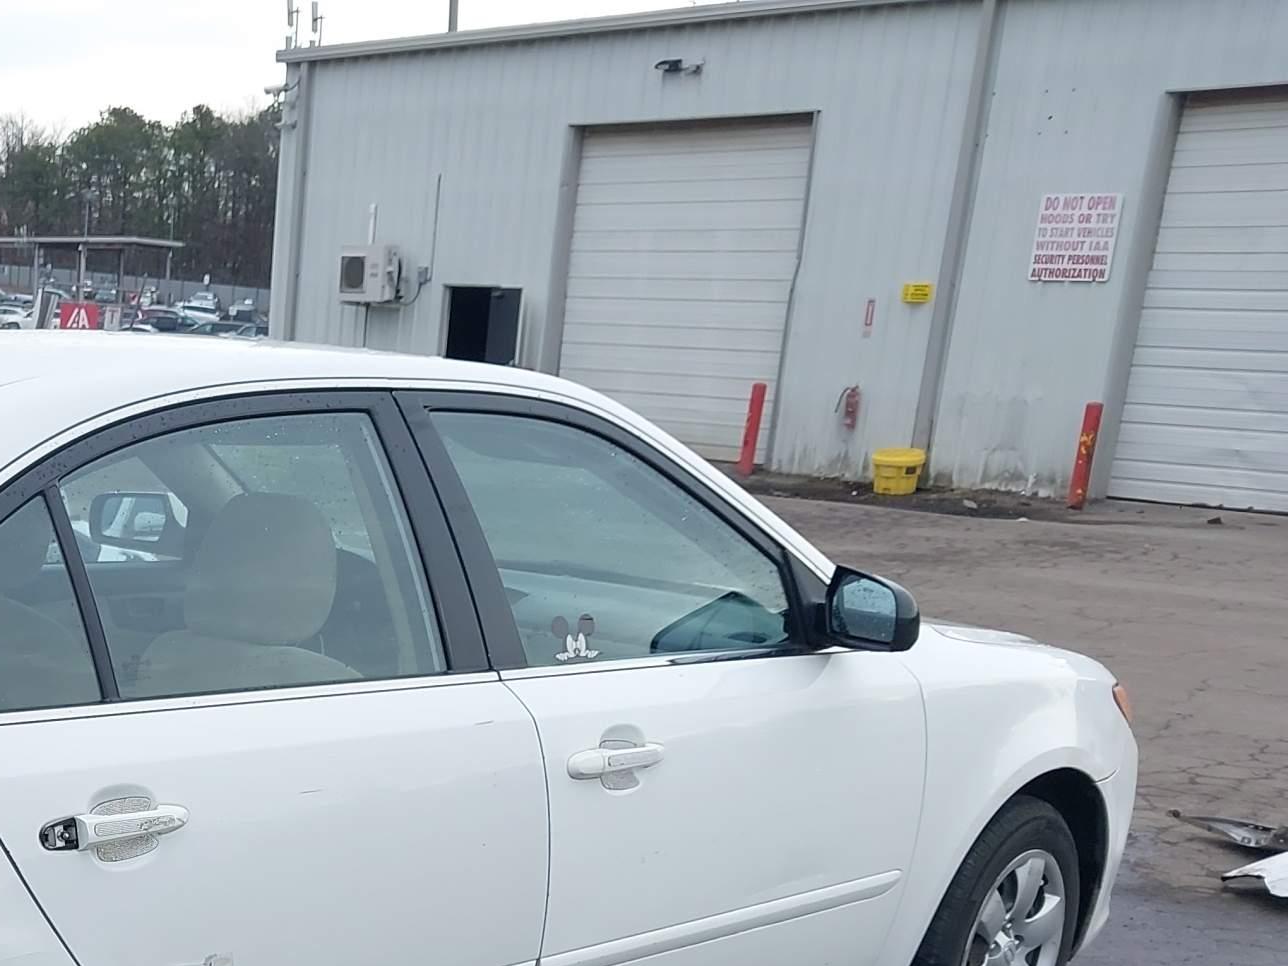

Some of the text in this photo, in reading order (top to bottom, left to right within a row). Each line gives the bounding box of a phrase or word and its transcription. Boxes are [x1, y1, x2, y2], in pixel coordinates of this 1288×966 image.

[1045, 196, 1117, 211] DO NOT OPEN
[1040, 214, 1116, 224] HOODS OR TRY
[1038, 227, 1115, 238] TO START VEHICLES
[1036, 241, 1109, 251] WITHOUT IAA
[1033, 255, 1108, 265] SECURITY PERSONNEL
[1031, 268, 1105, 278] AUTHORIZATION
